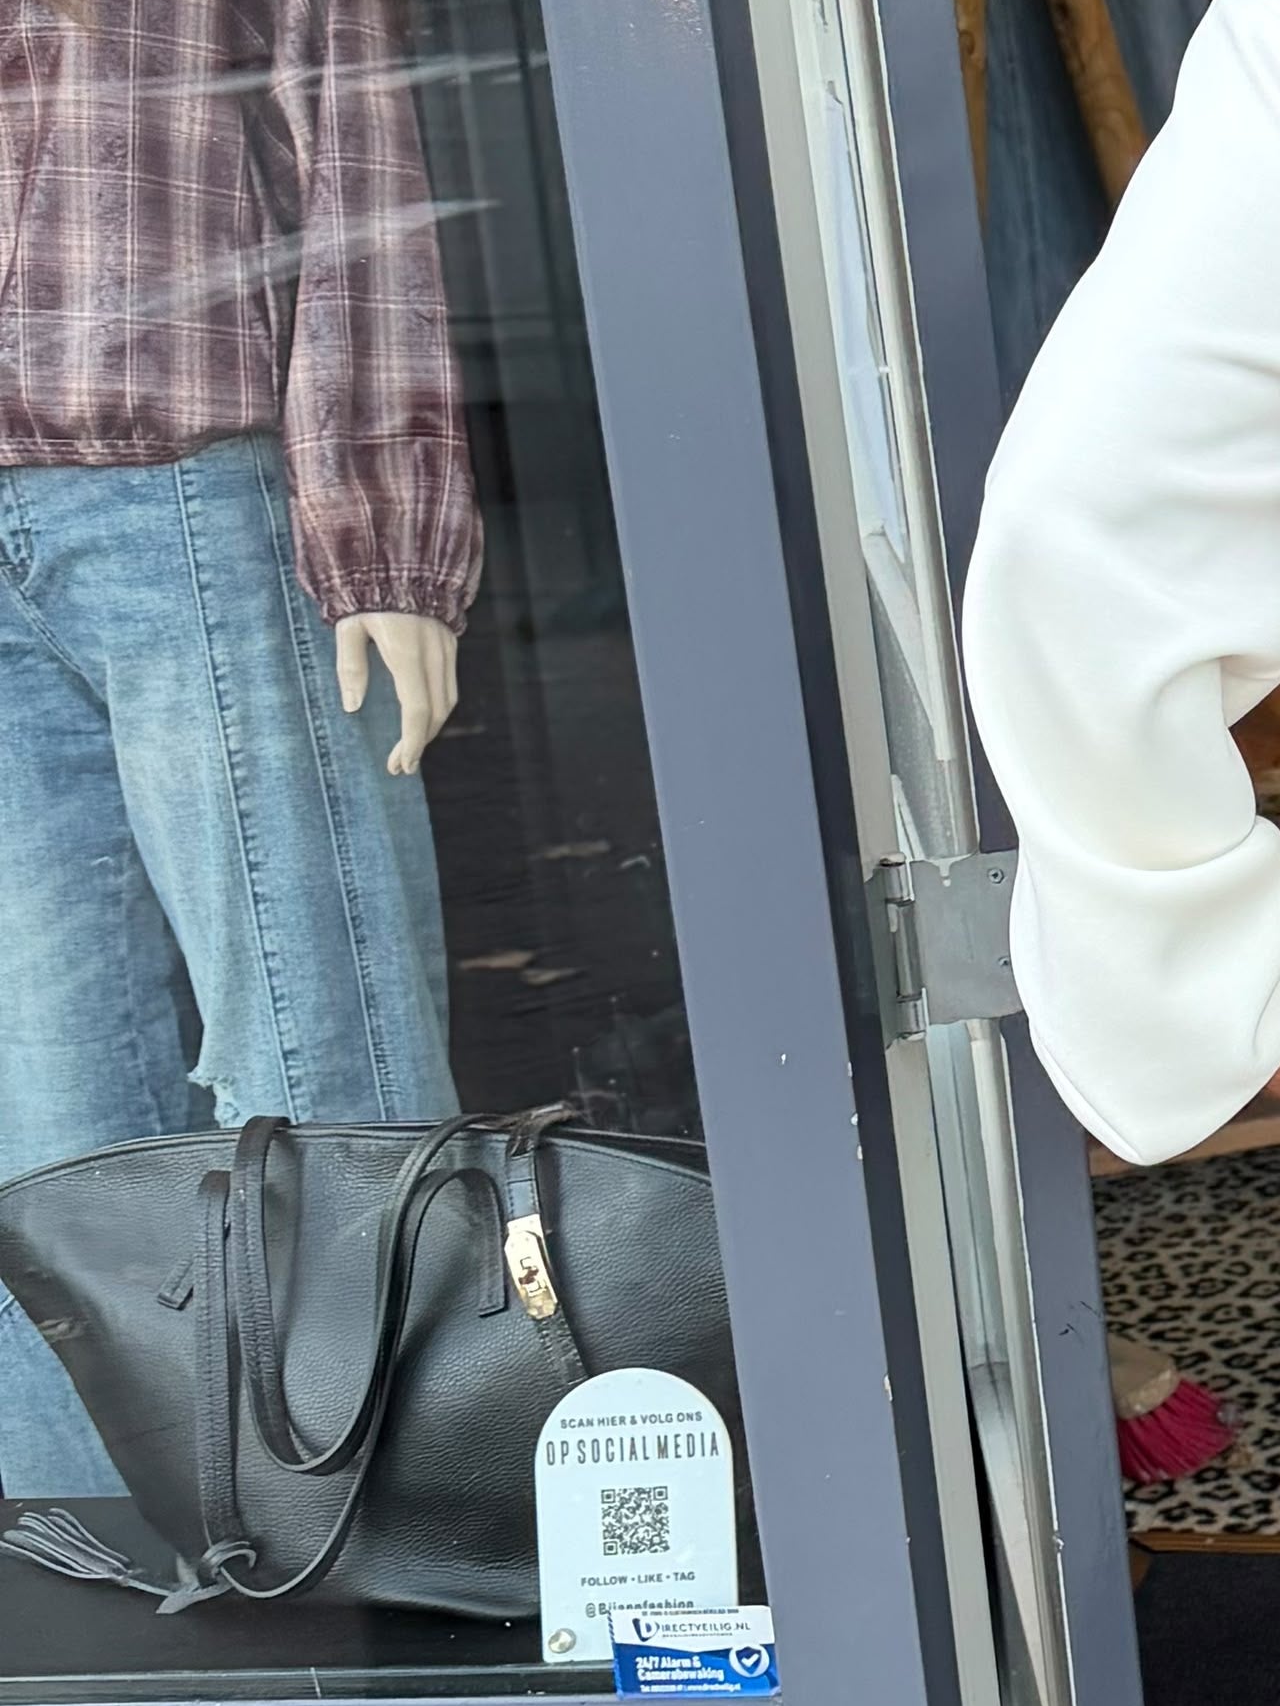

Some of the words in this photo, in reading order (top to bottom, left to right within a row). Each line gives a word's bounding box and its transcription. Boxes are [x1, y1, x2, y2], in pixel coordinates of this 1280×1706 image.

[560, 1417, 594, 1429] SCAN
[597, 1415, 627, 1427] HIER
[630, 1415, 638, 1425] &
[640, 1412, 674, 1424] VOLG
[676, 1411, 703, 1423] ONS
[546, 1440, 570, 1466] OP
[577, 1435, 650, 1464] SOCIAL
[657, 1431, 719, 1459] MEDIA
[580, 1575, 628, 1587] FOLLOW
[637, 1573, 664, 1584] LIKE
[672, 1571, 696, 1582] TAG
[635, 1656, 659, 1670] 24/7
[660, 1656, 691, 1668] Alarm
